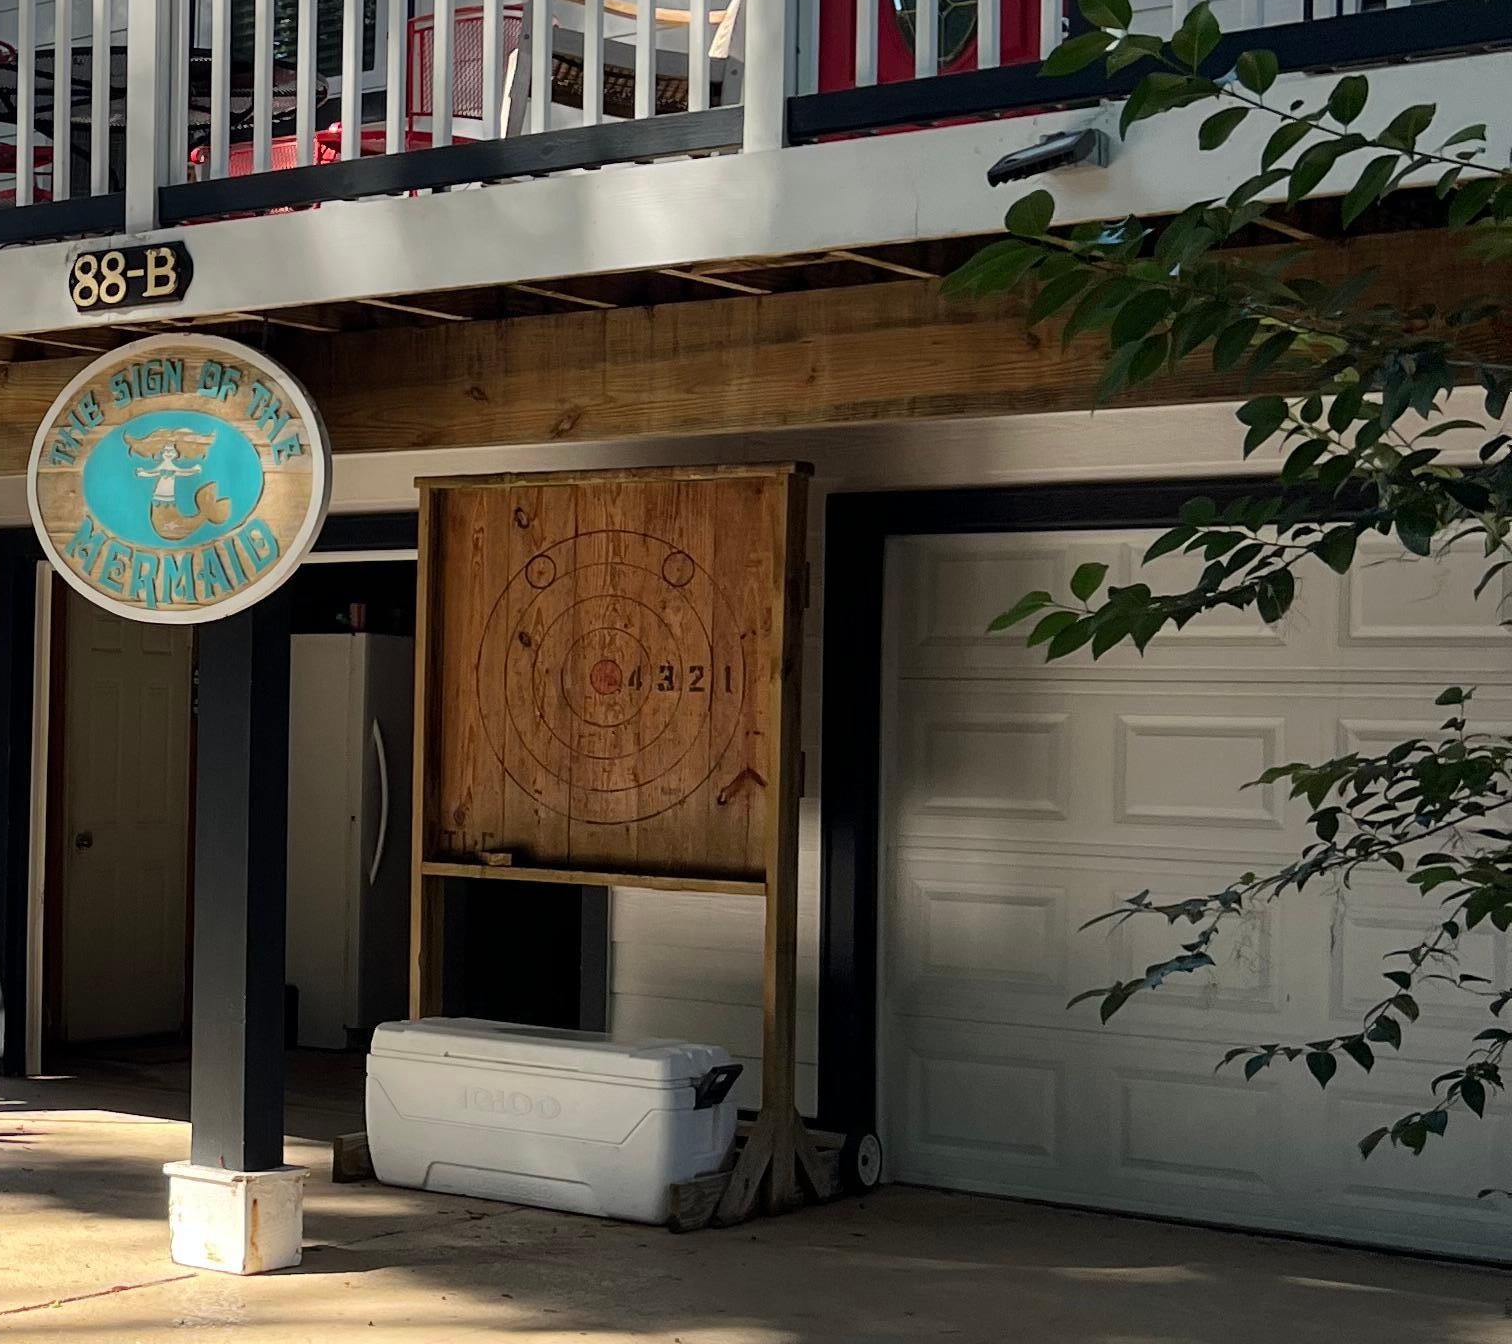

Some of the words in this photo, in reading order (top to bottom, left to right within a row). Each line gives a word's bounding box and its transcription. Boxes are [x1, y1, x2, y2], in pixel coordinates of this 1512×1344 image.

[73, 247, 177, 307] 88-B
[49, 390, 105, 466] THE
[109, 358, 185, 409] SIGN
[197, 359, 242, 402] OF
[245, 379, 304, 466] THE
[63, 514, 280, 610] MERMAID
[627, 664, 643, 692] 4
[657, 664, 675, 693] 3
[688, 665, 706, 693] 2
